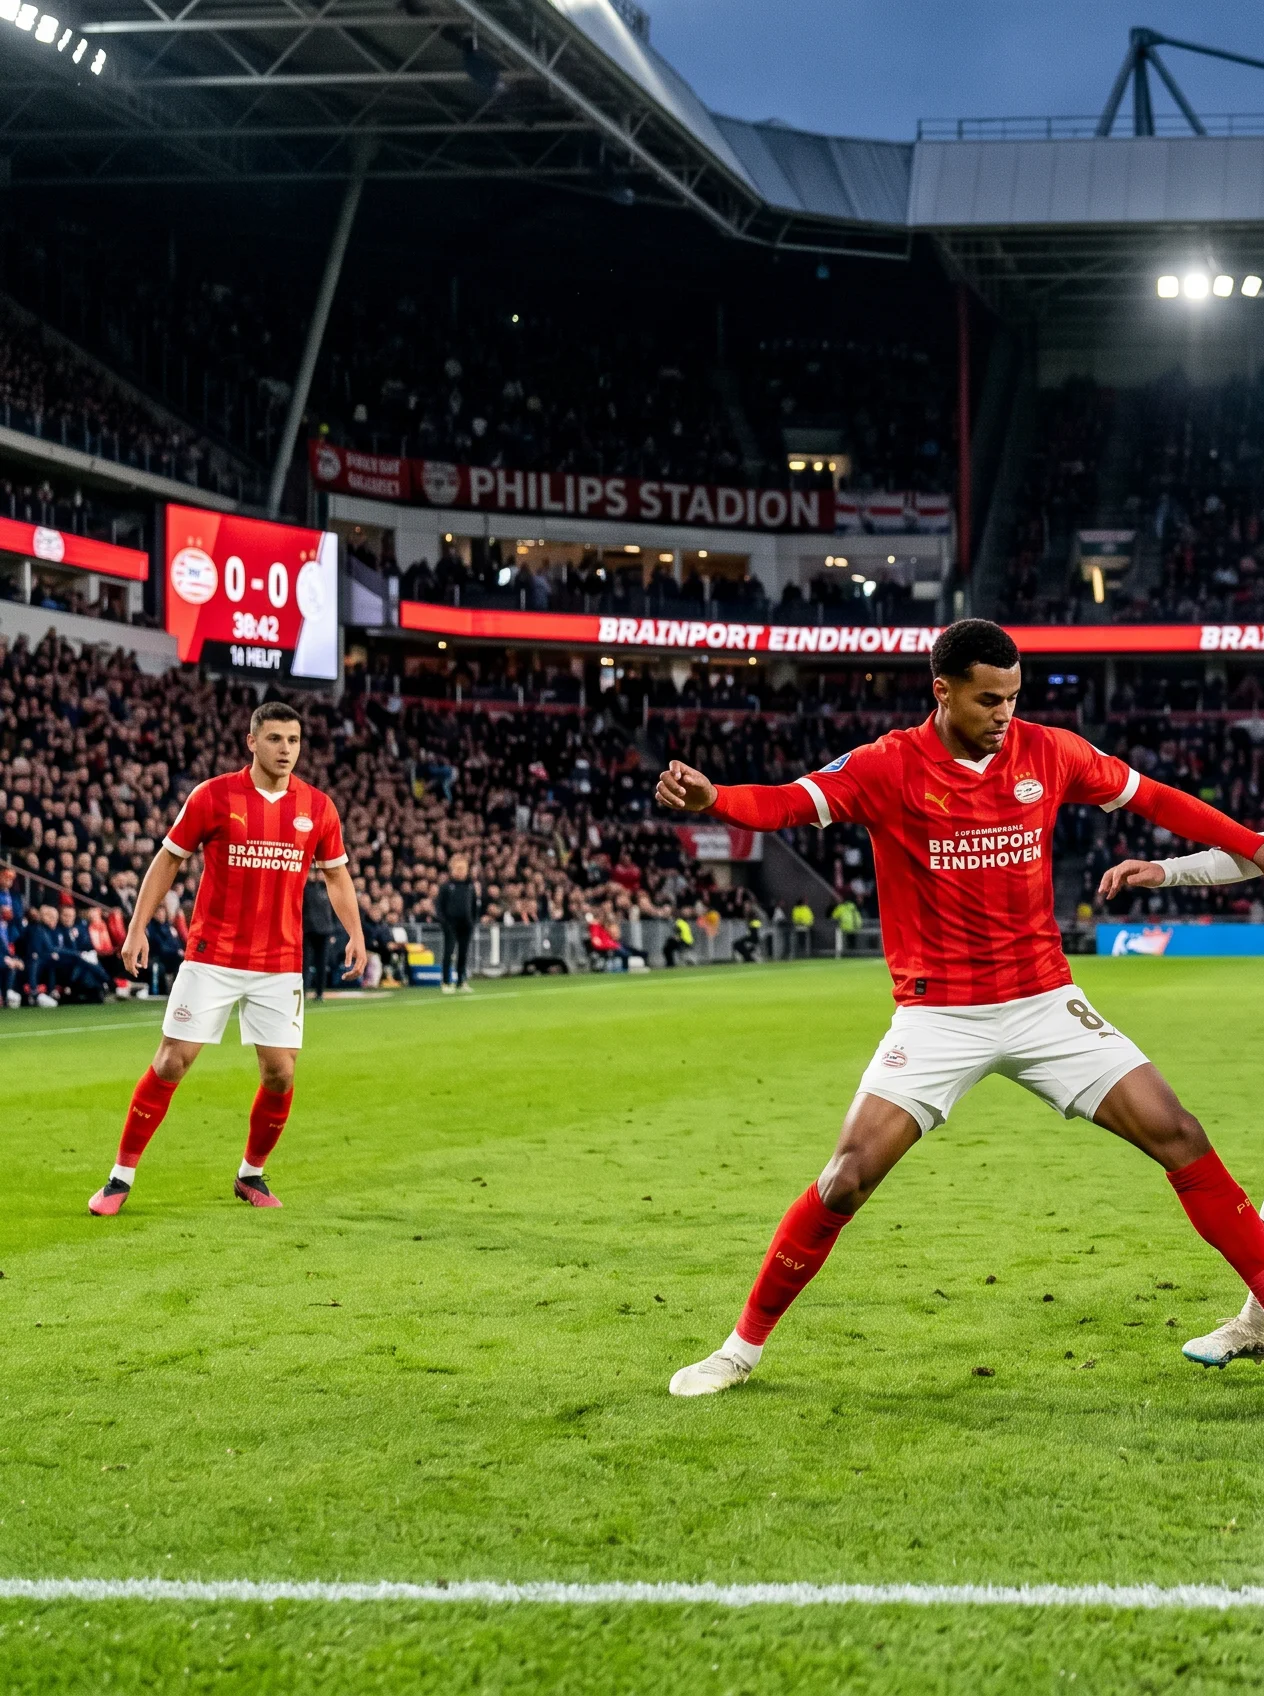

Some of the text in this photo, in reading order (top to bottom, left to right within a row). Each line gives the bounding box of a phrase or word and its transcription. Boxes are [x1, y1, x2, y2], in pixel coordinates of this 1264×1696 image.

[469, 466, 821, 528] PHILIPS STADION
[599, 617, 940, 652] BRAINPORT EINDHOVEN
[929, 828, 1042, 853] BRAINPORT
[228, 855, 302, 873] EINDHOVEN
[930, 844, 1042, 870] EINDHOVEN
[293, 989, 302, 1017] 7
[1066, 999, 1104, 1030] 8
